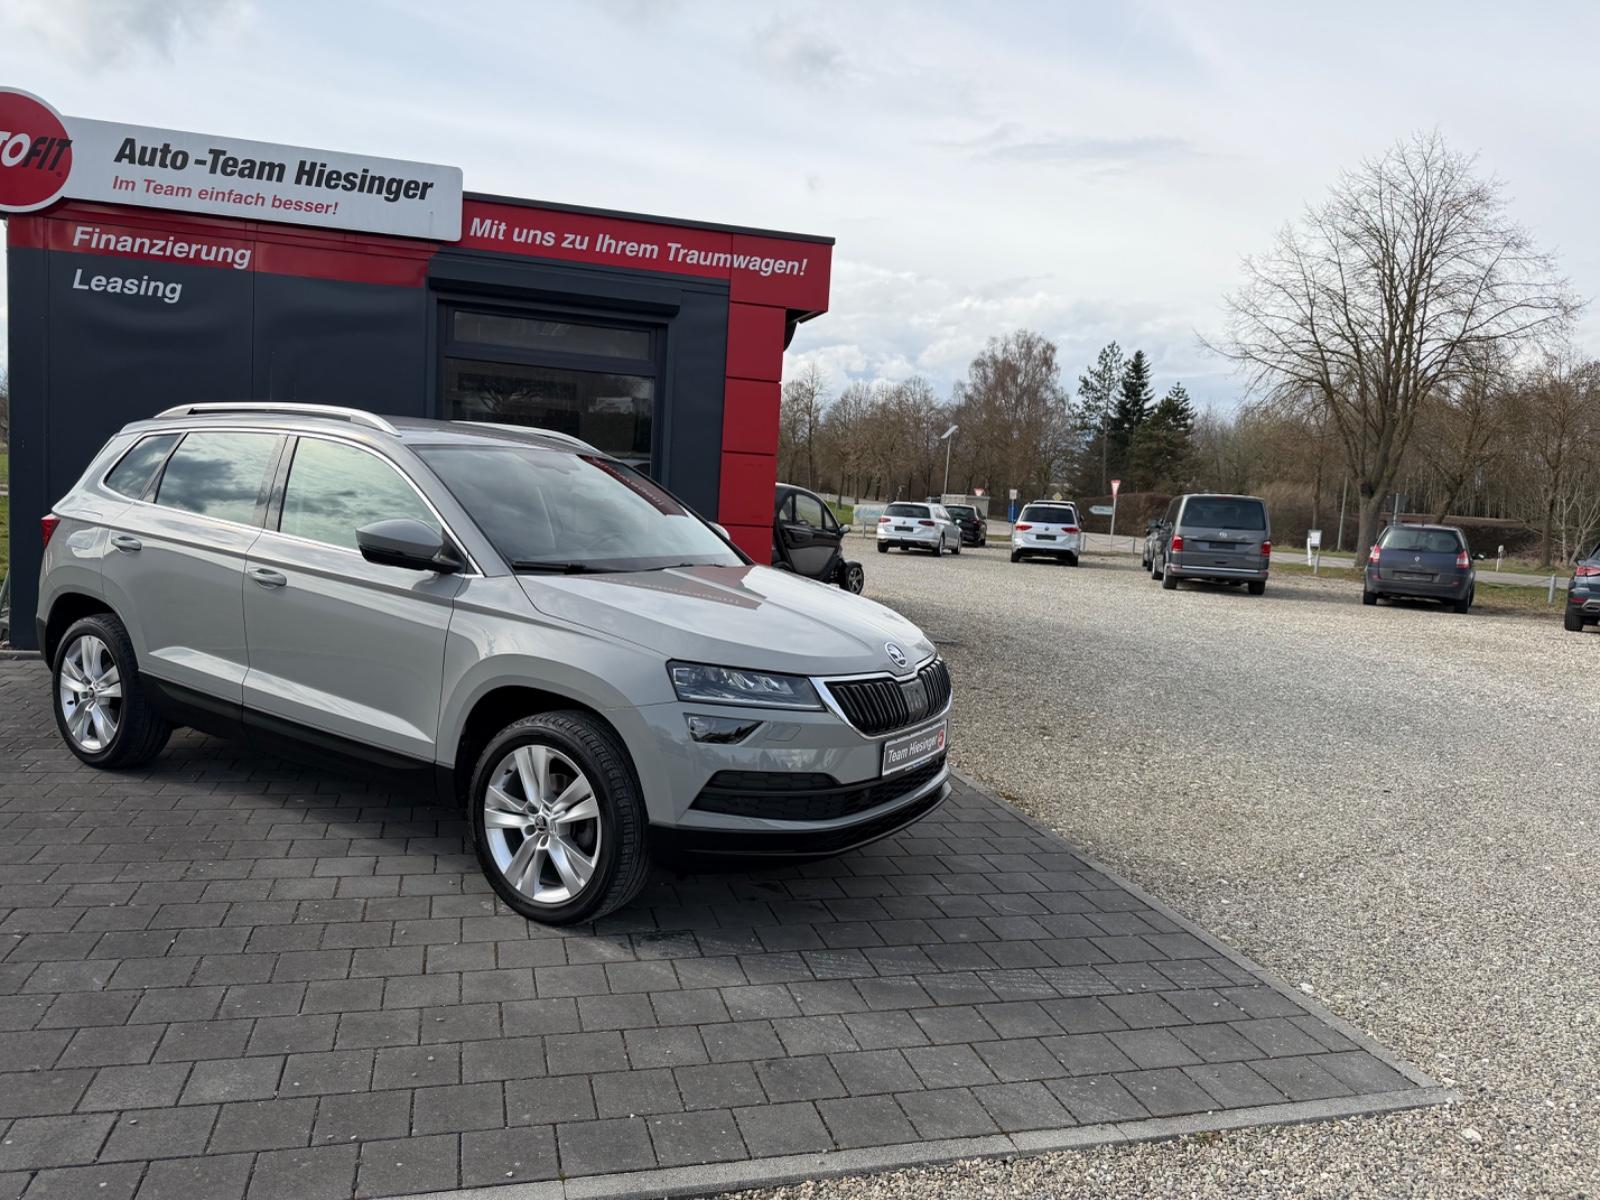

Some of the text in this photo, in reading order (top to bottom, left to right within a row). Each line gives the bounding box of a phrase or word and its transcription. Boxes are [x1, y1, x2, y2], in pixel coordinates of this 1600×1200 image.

[112, 175, 339, 216] Im Team einfach besser!
[294, 160, 434, 203] Hiesinger
[72, 226, 252, 270] Finanzierung
[469, 217, 808, 277] Mit uns zu Ihrem Traumwagen!
[72, 269, 183, 303] Leasing
[888, 748, 908, 763] Team
